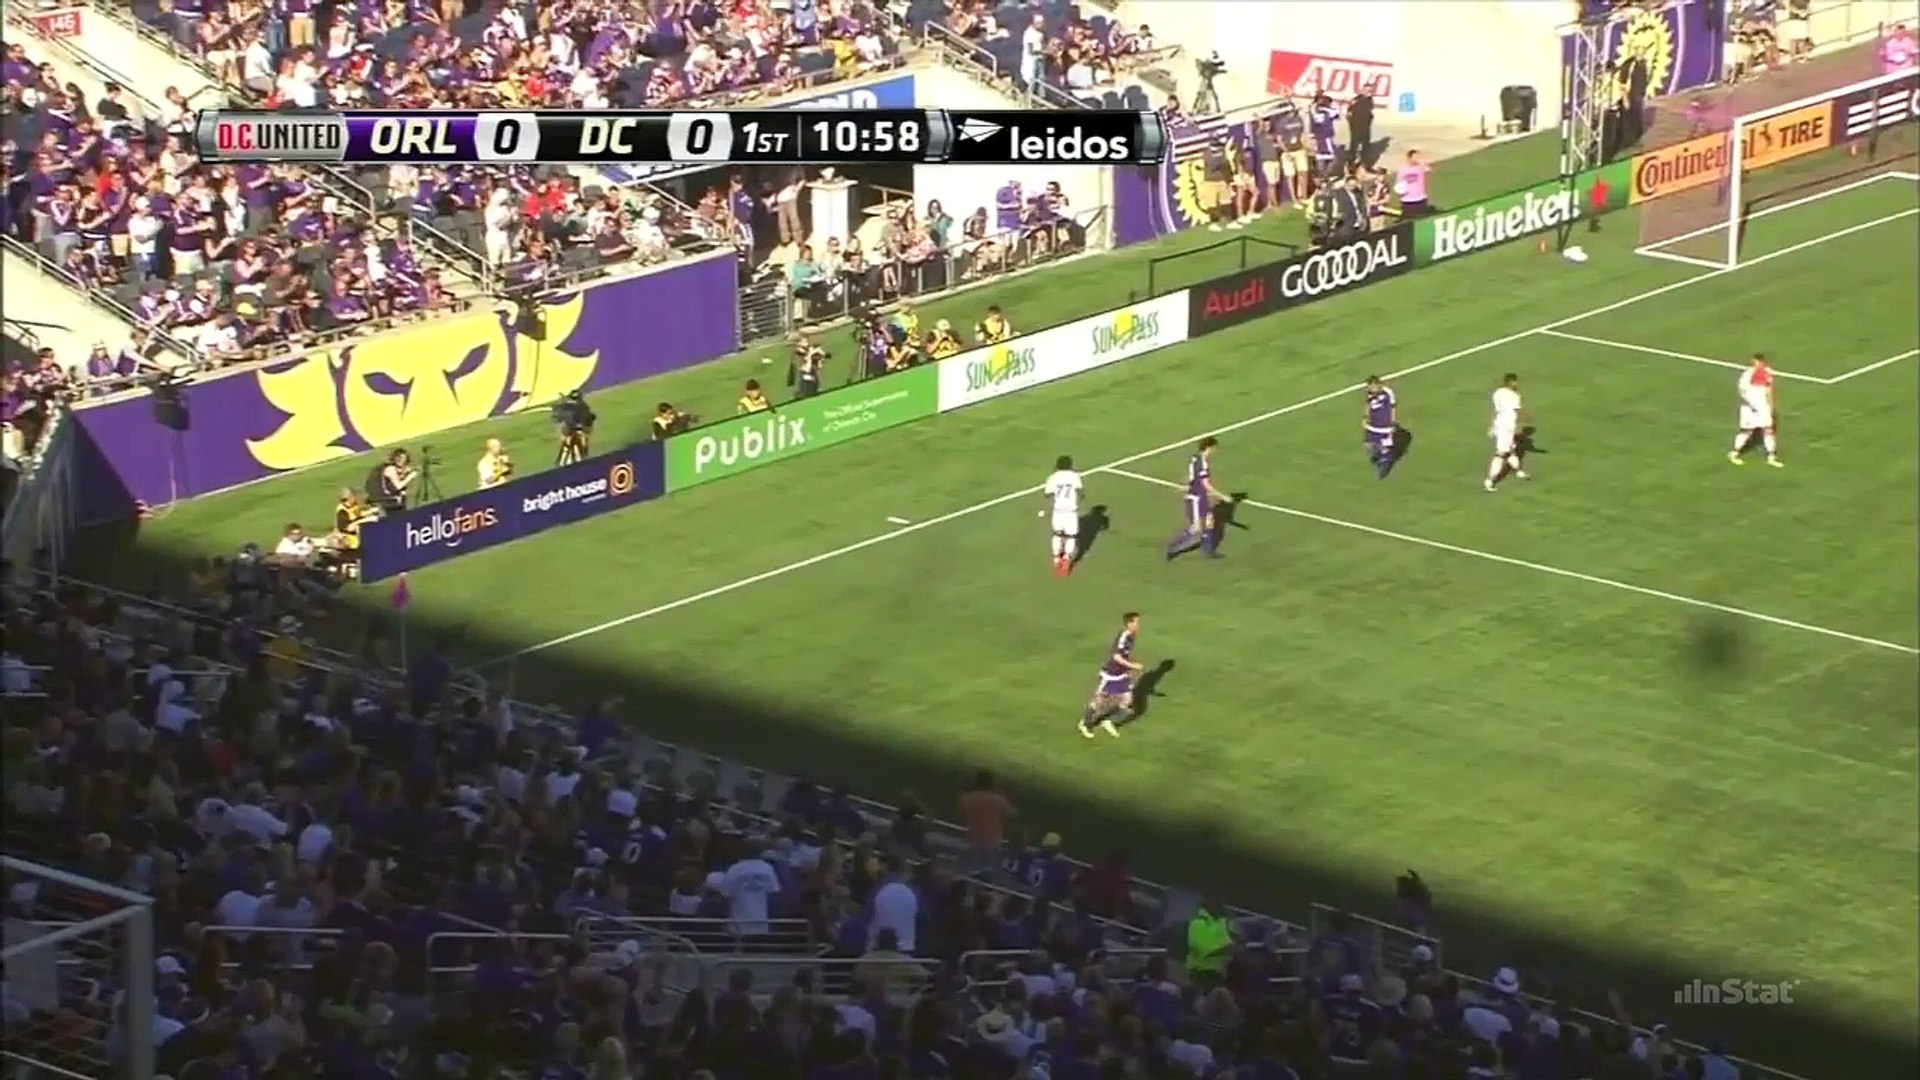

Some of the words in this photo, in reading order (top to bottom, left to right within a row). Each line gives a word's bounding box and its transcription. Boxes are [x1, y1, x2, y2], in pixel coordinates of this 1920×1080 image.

[1779, 115, 1825, 149] TIRE
[1431, 188, 1581, 260] Heineken
[1203, 277, 1265, 318] Audi
[695, 414, 805, 473] Publix
[523, 488, 565, 513] bright
[565, 478, 608, 500] house
[1056, 483, 1073, 499] 77
